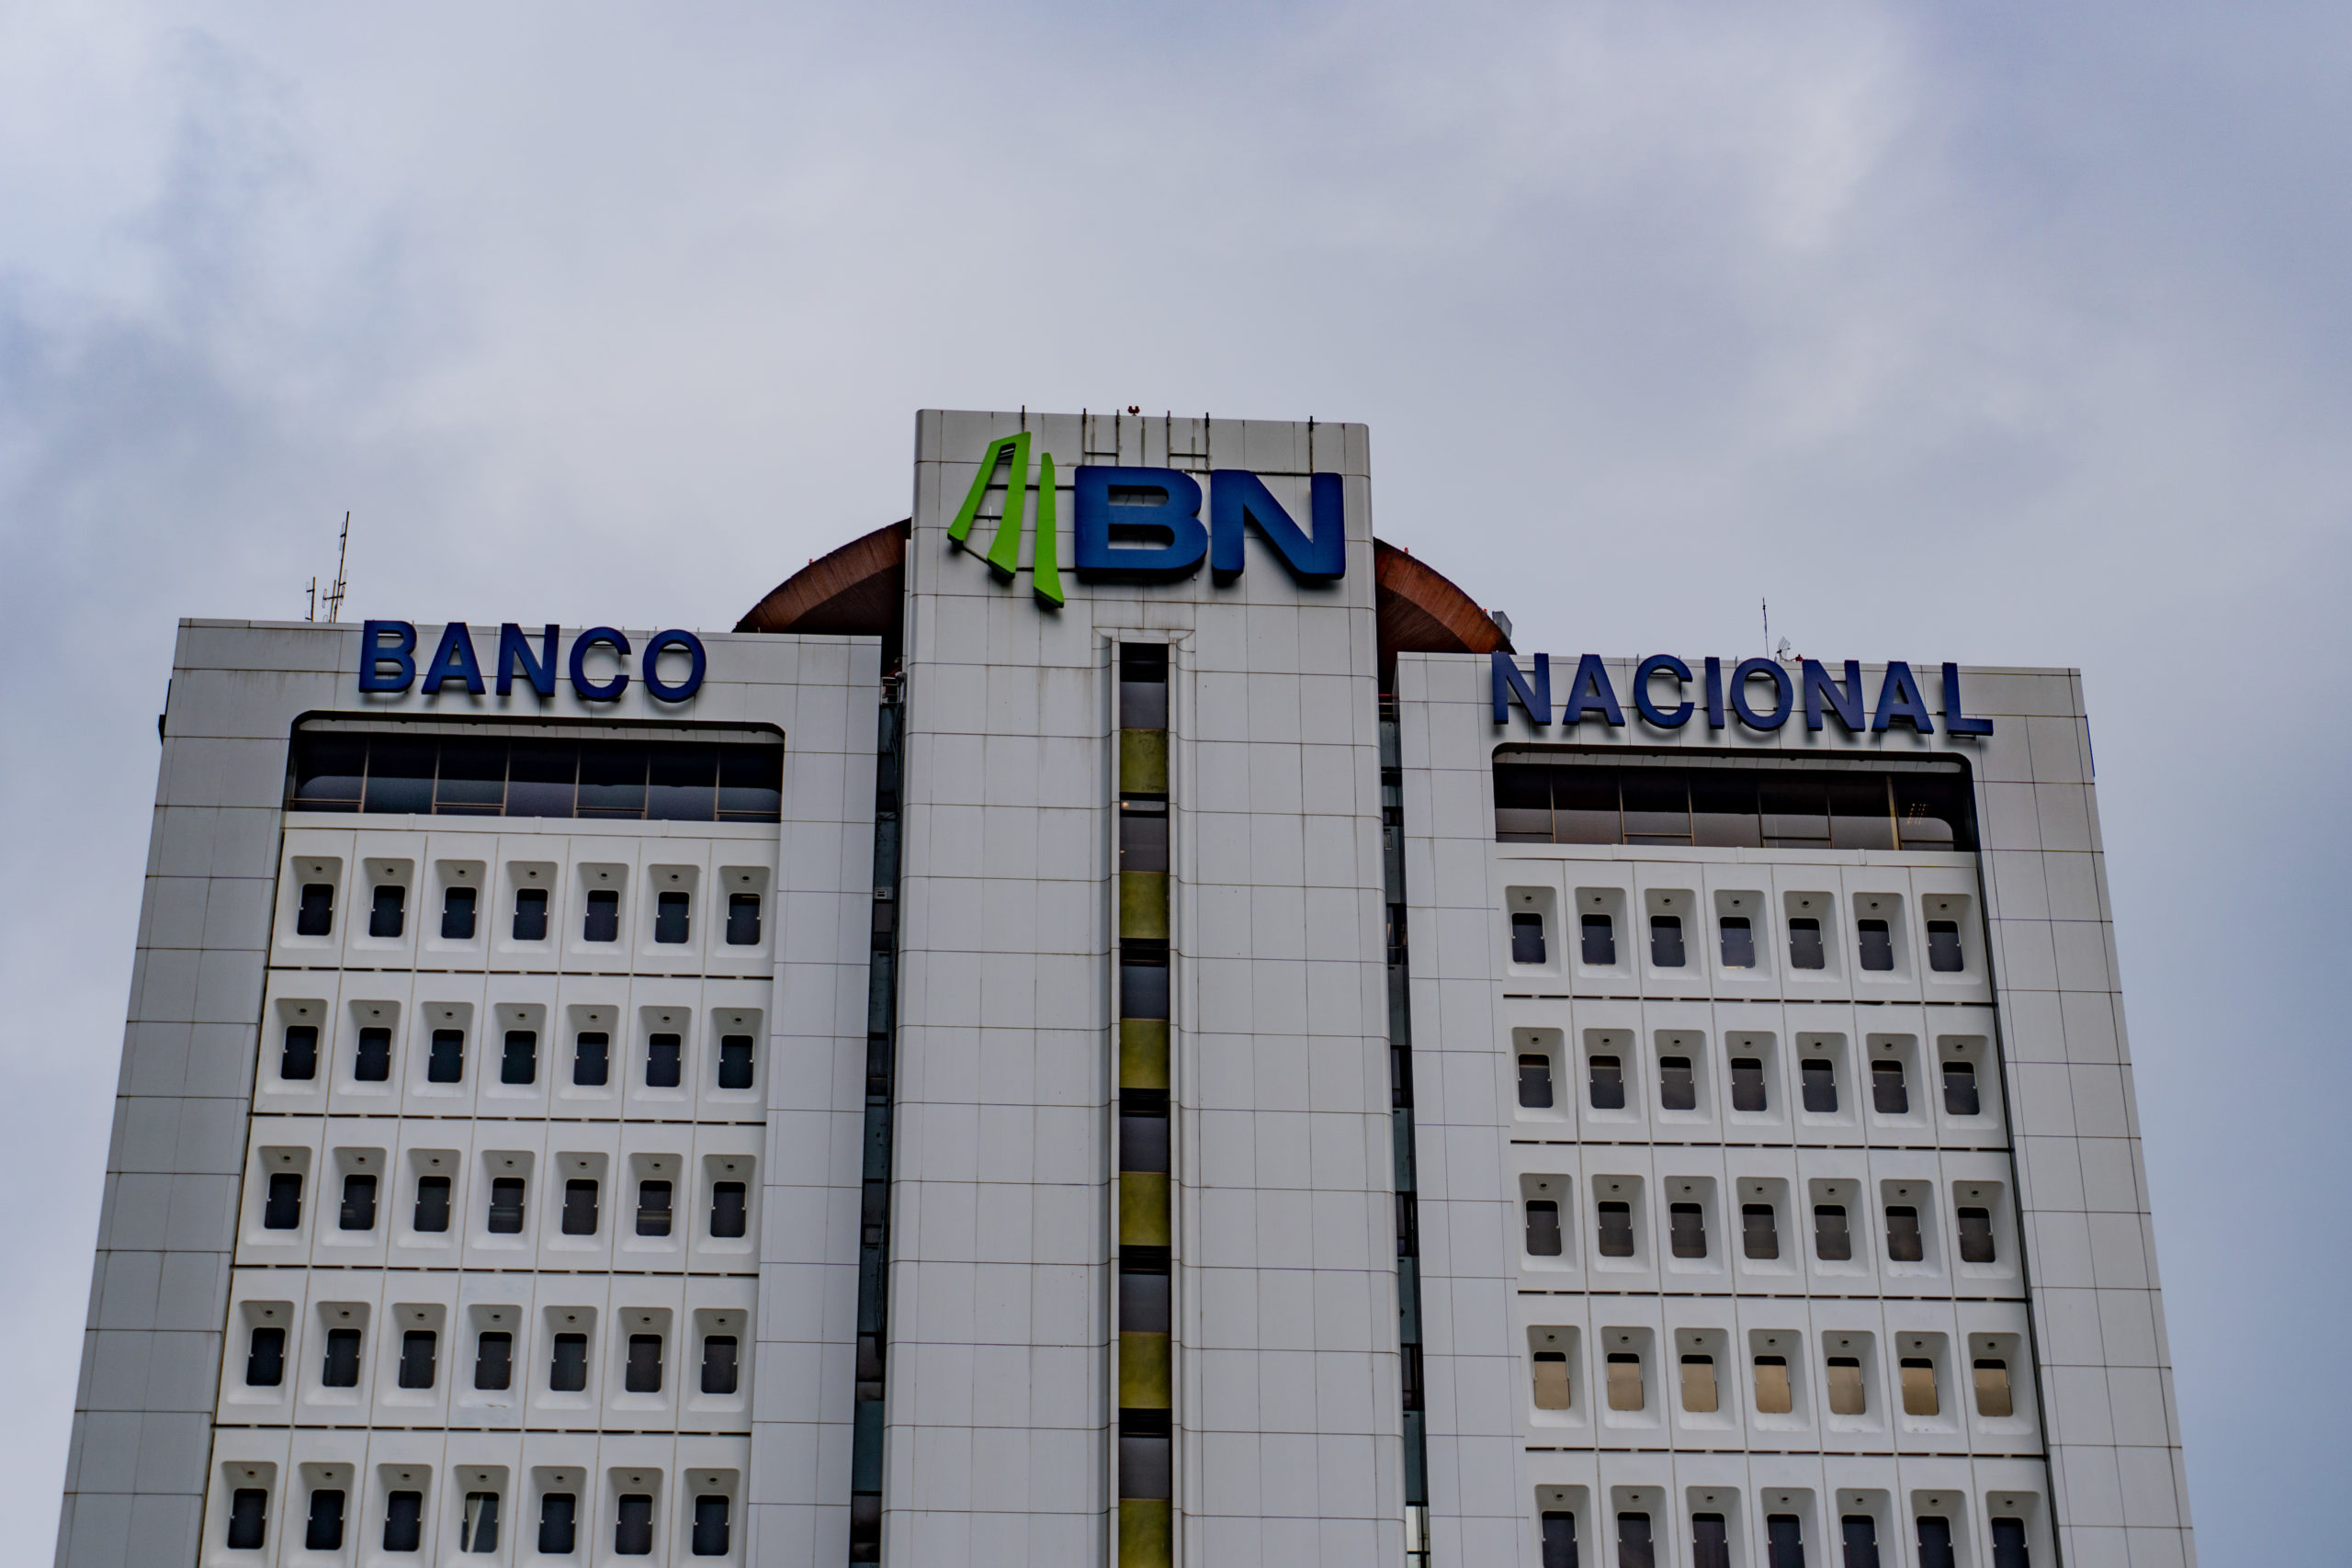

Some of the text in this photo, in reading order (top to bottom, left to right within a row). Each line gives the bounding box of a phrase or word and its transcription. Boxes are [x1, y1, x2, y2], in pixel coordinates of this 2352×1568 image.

[1075, 465, 1345, 580] BN
[359, 620, 707, 703] BANCO
[1491, 651, 1994, 735] NACIONAL
